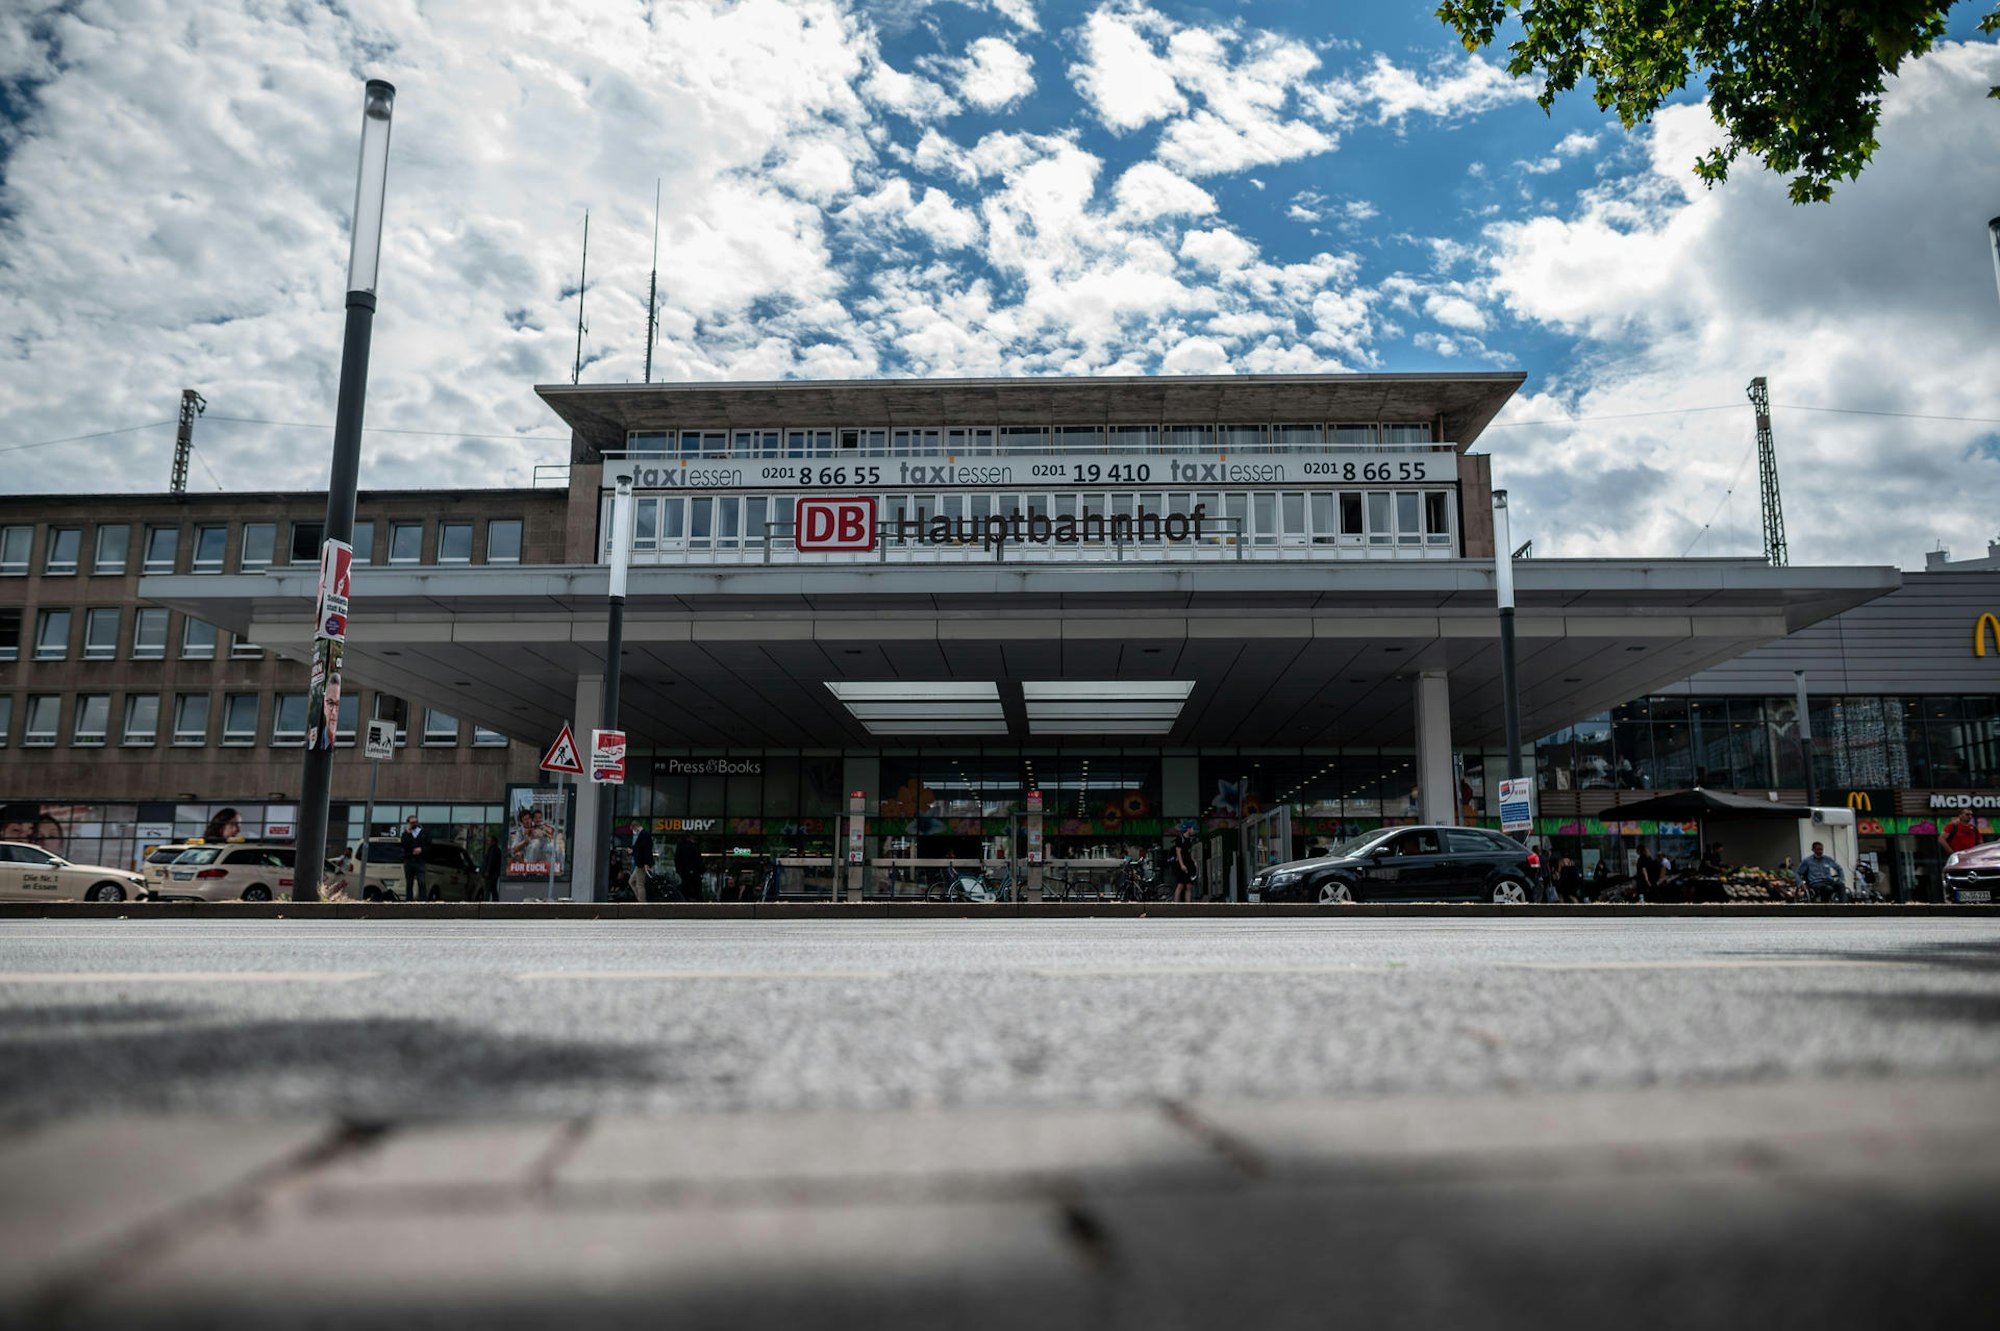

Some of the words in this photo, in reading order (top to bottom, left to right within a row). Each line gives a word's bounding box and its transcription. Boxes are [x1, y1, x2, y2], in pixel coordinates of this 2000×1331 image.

[762, 467, 796, 479] 0201
[799, 467, 812, 485] 8
[819, 467, 847, 485] 66
[854, 467, 881, 485] 55
[1032, 465, 1066, 477] 0201
[1073, 464, 1101, 483] 19
[1107, 464, 1151, 483] 410
[1303, 462, 1338, 475] 0201
[1343, 462, 1356, 481] 8
[1363, 462, 1392, 481] 66
[1399, 462, 1427, 480] 55
[805, 505, 866, 543] DB
[897, 503, 1206, 552] Hauptbahnhof
[655, 819, 716, 831] SUBWAY
[510, 862, 525, 872] FÜR
[23, 873, 38, 882] Die
[22, 882, 31, 890] in
[33, 882, 58, 890] Essen
